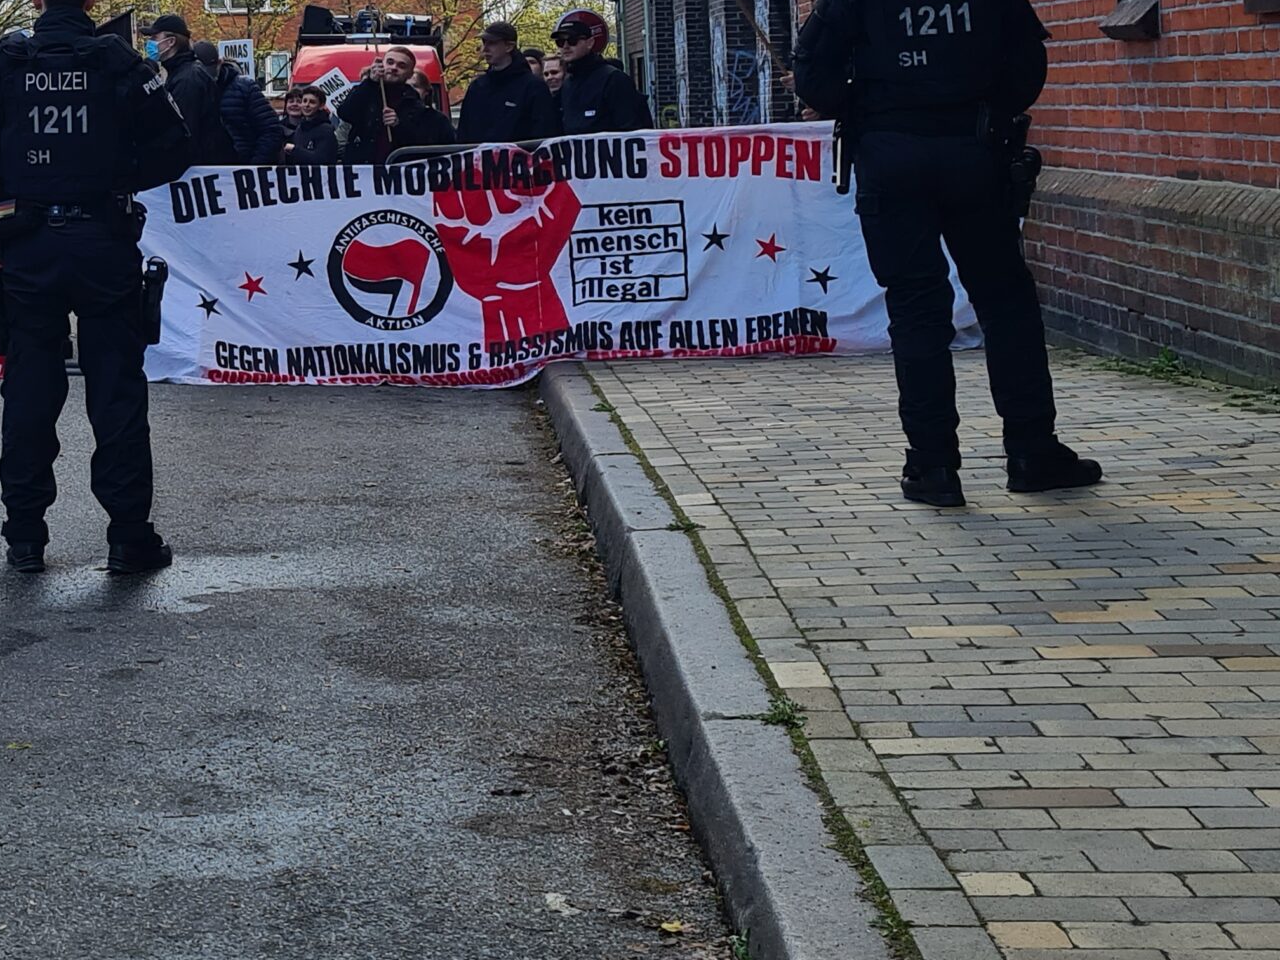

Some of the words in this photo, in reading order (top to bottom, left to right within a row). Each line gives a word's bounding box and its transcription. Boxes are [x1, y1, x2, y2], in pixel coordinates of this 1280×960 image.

[899, 2, 972, 36] 1211
[224, 44, 248, 58] OMAS
[899, 50, 927, 66] SH
[25, 71, 88, 91] POLIZEI
[320, 74, 345, 96] OMAS
[28, 105, 88, 134] 1211
[27, 149, 51, 164] SH
[172, 174, 226, 224] DIE
[233, 164, 362, 211] RECHTE
[372, 137, 647, 196] MOBILMACHUNG
[658, 134, 821, 181] STOPPEN
[599, 206, 653, 226] kein
[334, 212, 446, 255] ANTIFASCHISTISCHE
[576, 227, 678, 254] mensch
[600, 255, 634, 275] ist
[581, 279, 660, 303] illegal
[365, 314, 425, 330] AKTION
[215, 341, 280, 374] GEGEN
[285, 342, 461, 377] NATIONALISMUS
[468, 342, 482, 371] &
[489, 320, 613, 368] RASSISMUS
[620, 320, 664, 351] AUF
[668, 318, 738, 350] ALLEN
[745, 307, 828, 344] EBENEN
